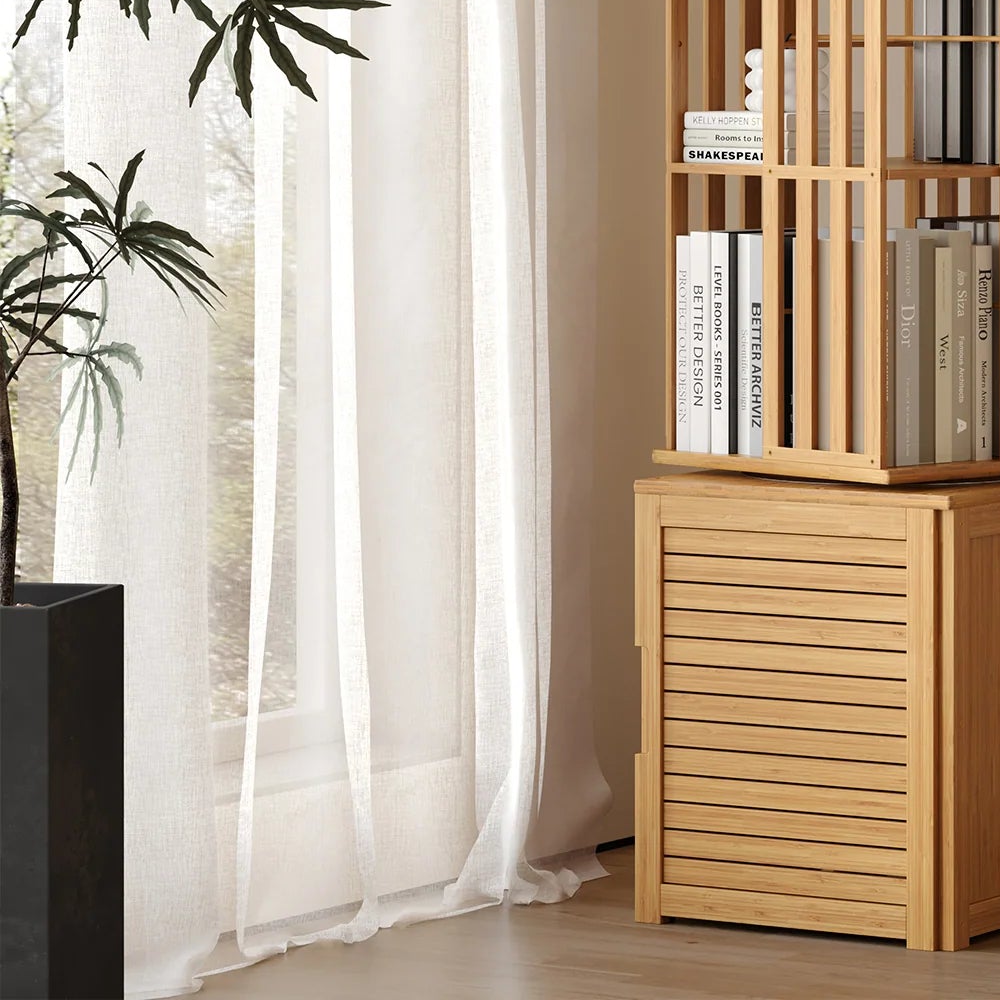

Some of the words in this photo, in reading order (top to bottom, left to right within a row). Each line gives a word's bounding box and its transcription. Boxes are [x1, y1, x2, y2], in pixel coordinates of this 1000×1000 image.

[693, 116, 717, 125] KELLY
[718, 117, 749, 126] HOPPEN
[751, 117, 761, 126] ST
[715, 134, 742, 142] Rooms
[714, 265, 723, 299] LEVEL
[978, 269, 992, 305] Renzo
[678, 269, 687, 335] PROTECT
[693, 285, 704, 342] BETTER
[957, 290, 968, 318] Siza
[714, 301, 723, 342] BOOKS
[751, 302, 762, 361] BETTER
[901, 303, 916, 348] Dior
[978, 307, 992, 341] Piano
[678, 336, 687, 368] OUR
[714, 350, 723, 388] SERIES
[939, 334, 949, 370] West
[693, 346, 704, 407] DESIGN
[741, 377, 749, 411] Design
[678, 371, 687, 424] DESIGN
[714, 391, 723, 411] 001
[751, 364, 762, 428] ARCHVIZ
